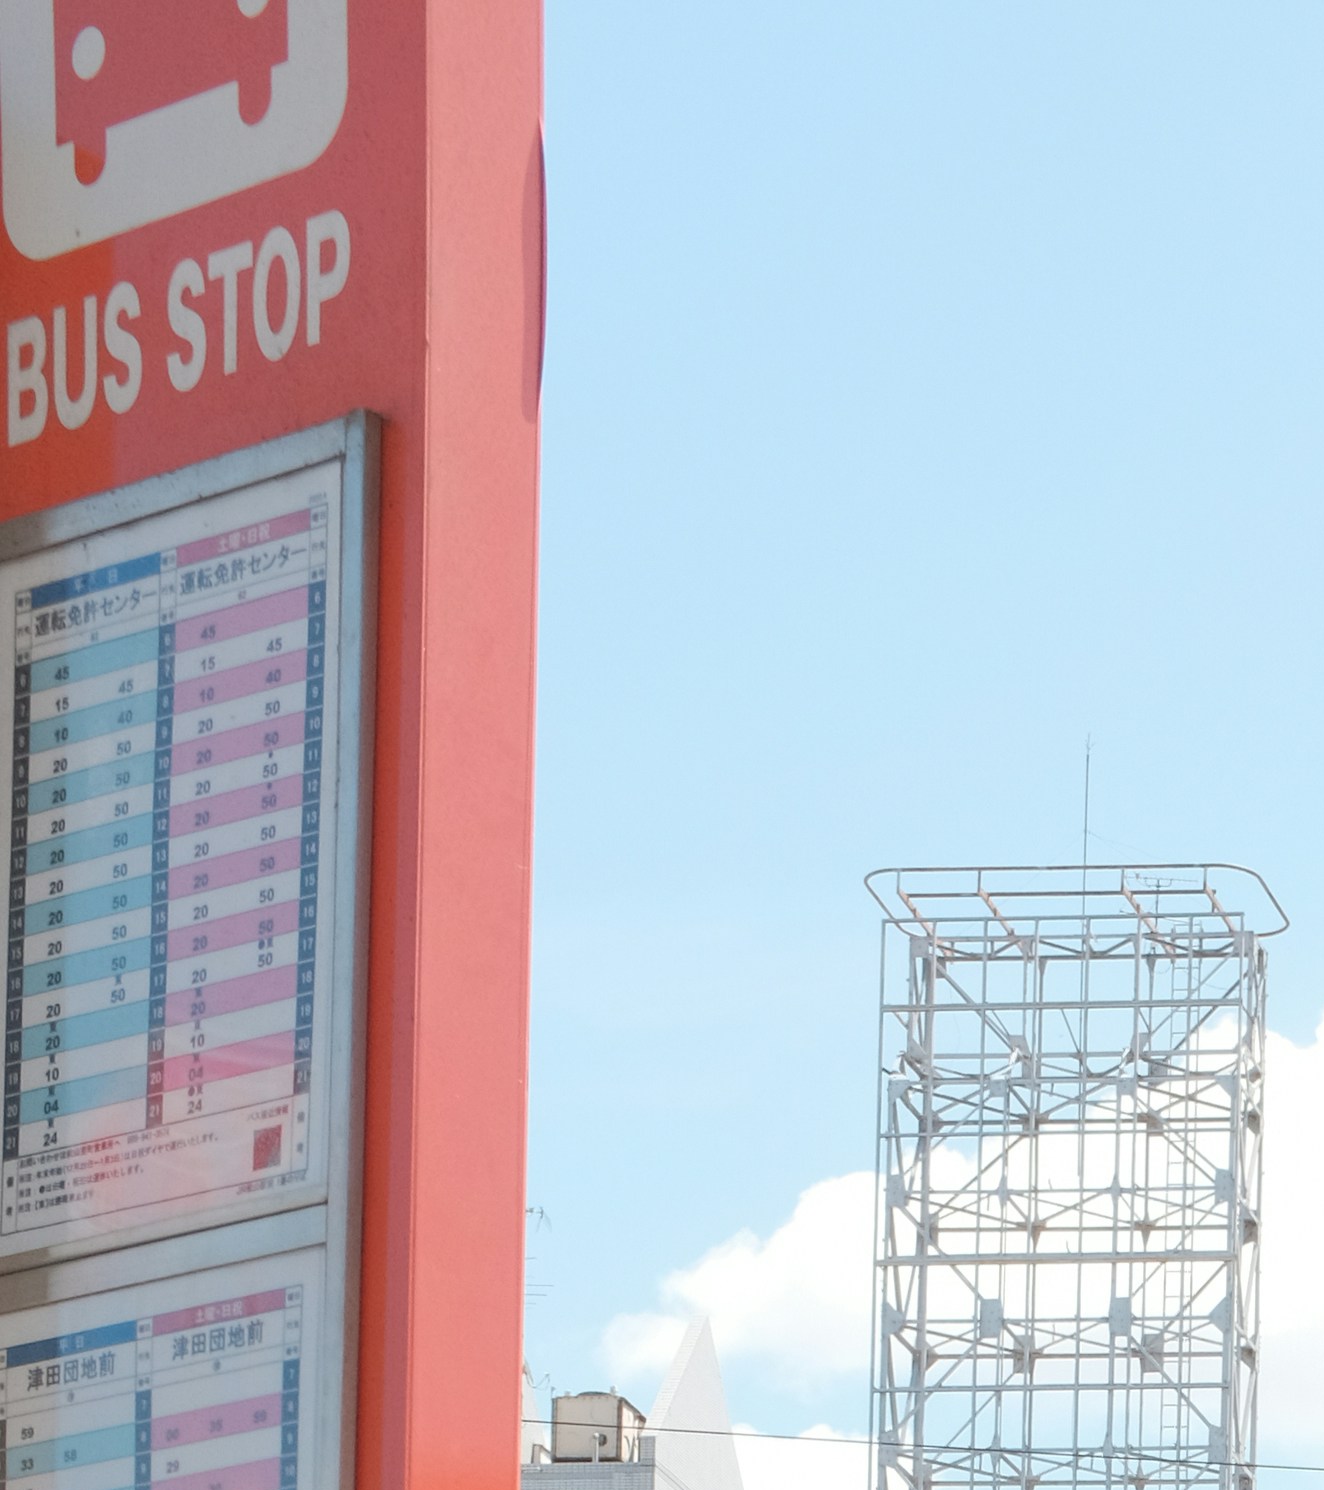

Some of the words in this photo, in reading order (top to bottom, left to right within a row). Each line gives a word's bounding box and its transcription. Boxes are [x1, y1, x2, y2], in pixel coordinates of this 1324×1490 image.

[7, 282, 142, 447] BUS
[167, 209, 350, 392] STOP
[179, 545, 308, 595] 運転免許センター
[34, 590, 157, 638] 運転免許センター
[201, 625, 216, 639] 45
[201, 656, 215, 672] 15
[266, 638, 282, 652] 45
[54, 666, 69, 680] 45
[200, 687, 214, 702] 10
[266, 669, 281, 683] 40
[56, 697, 69, 712] 15
[118, 679, 133, 693] 45
[54, 728, 68, 743] 10
[118, 710, 133, 724] 40
[198, 718, 213, 734] 20
[265, 700, 280, 716] 50
[53, 758, 67, 774] 20
[116, 740, 131, 756] 50
[196, 749, 212, 764] 20
[264, 731, 279, 747] 50
[52, 788, 66, 804] 20
[116, 771, 130, 786] 50
[195, 780, 210, 796] 20
[263, 763, 278, 778] 50
[51, 819, 65, 834] 20
[114, 802, 128, 817] 50
[195, 811, 210, 826] 20
[262, 794, 277, 809] 50
[50, 849, 64, 865] 20
[113, 832, 128, 848] 50
[194, 842, 209, 858] 20
[261, 825, 276, 841] 50
[49, 880, 63, 895] 20
[113, 863, 128, 878] 50
[194, 873, 209, 890] 20
[260, 856, 275, 872] 50
[48, 910, 63, 926] 20
[112, 894, 127, 910] 50
[194, 904, 208, 920] 20
[260, 888, 274, 903] 50
[48, 941, 62, 956] 20
[112, 925, 126, 940] 50
[47, 971, 62, 987] 20
[112, 956, 126, 971] 50
[46, 1004, 60, 1018] 20
[111, 988, 125, 1003] 50
[46, 1035, 60, 1051] 20
[46, 1068, 59, 1082] 10
[44, 1100, 59, 1114] 04
[43, 1132, 57, 1147] 24
[172, 1318, 264, 1361] 津田団地前
[27, 1351, 115, 1392] 津田団地前
